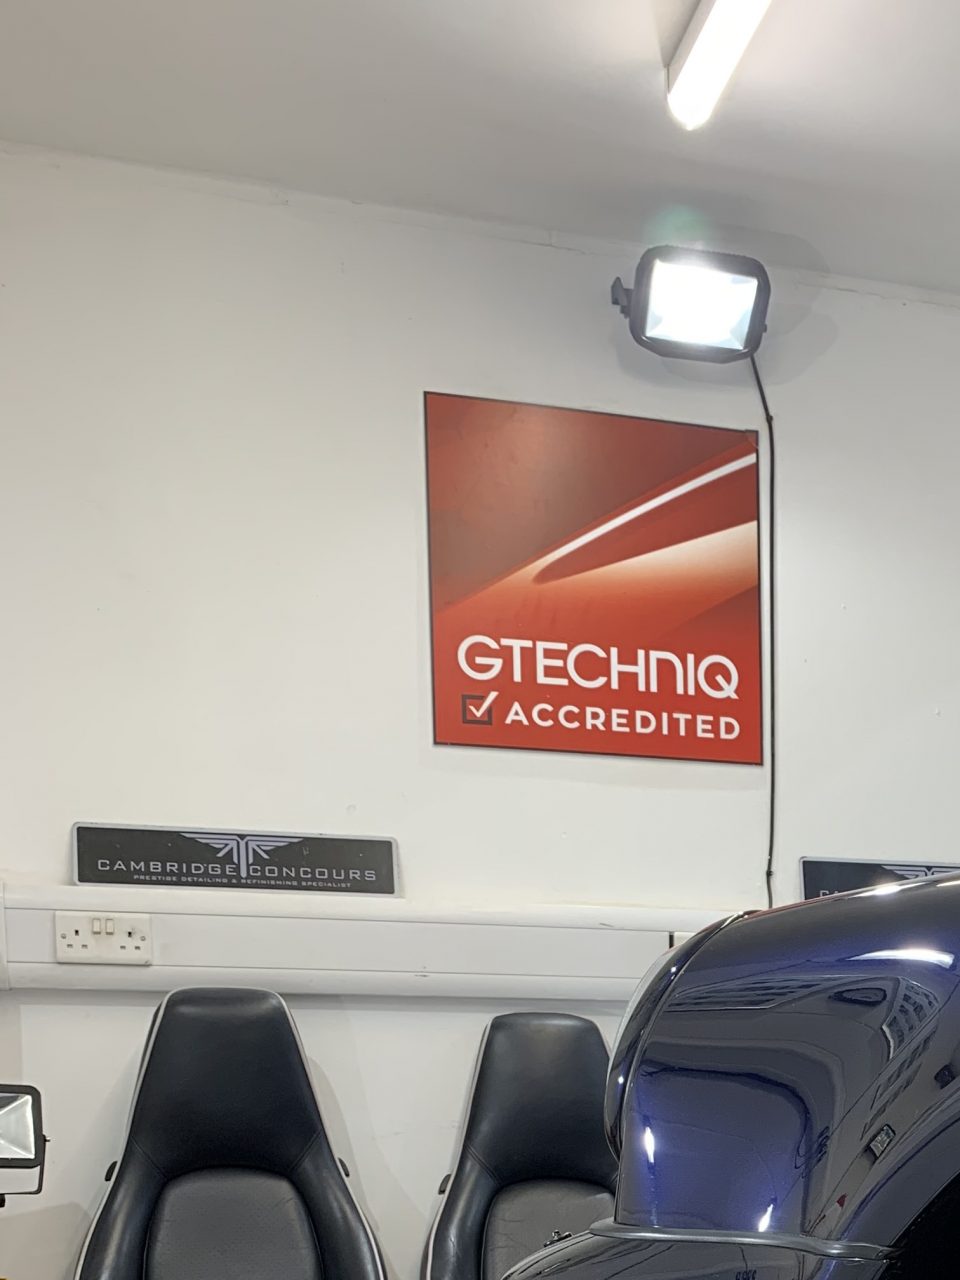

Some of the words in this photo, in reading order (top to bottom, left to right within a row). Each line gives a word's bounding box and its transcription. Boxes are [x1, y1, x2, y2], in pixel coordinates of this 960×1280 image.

[457, 634, 739, 700] GTECHNIQ
[505, 701, 740, 740] ACCREDITED
[97, 859, 236, 876] CAMBRIDGE
[249, 864, 377, 881] CONCOURS
[241, 878, 298, 886] REFINISHING
[301, 880, 351, 888] SPECIALIST
